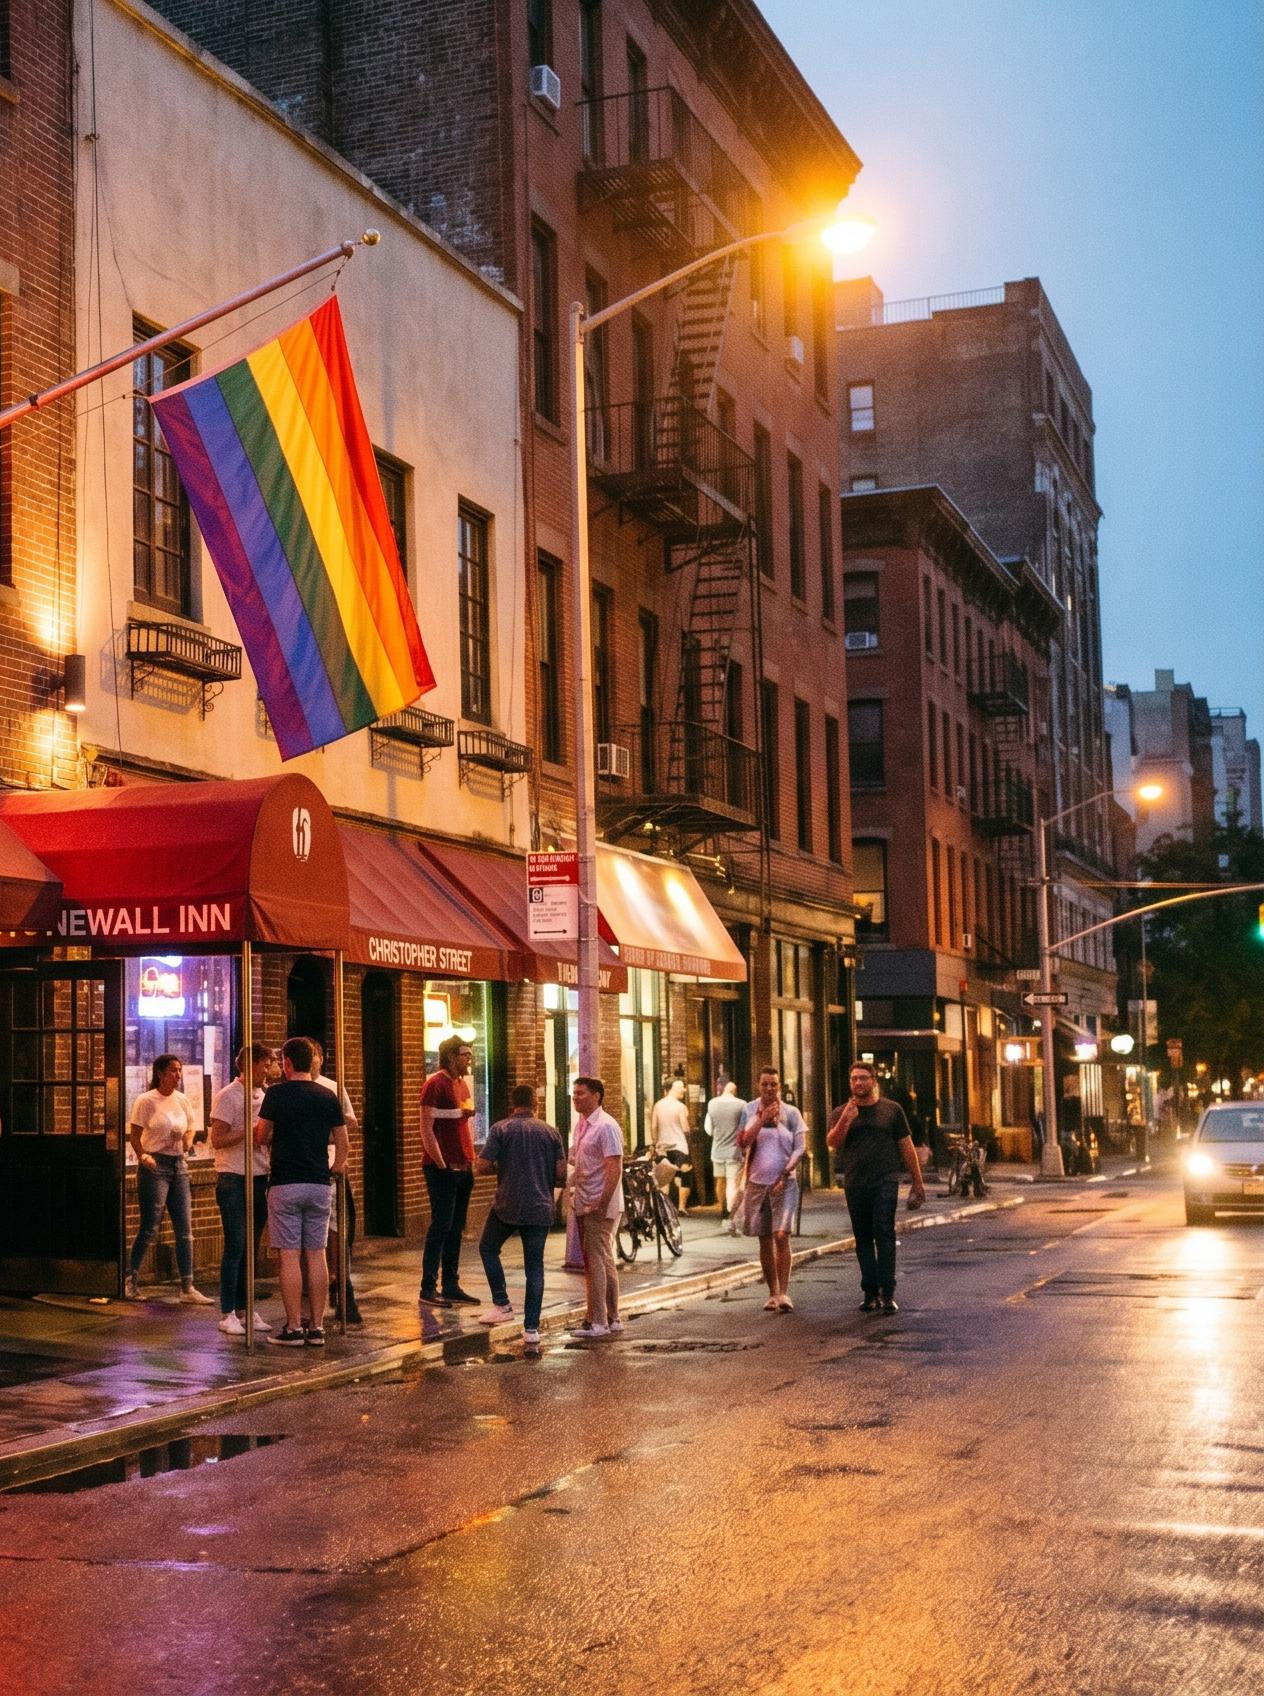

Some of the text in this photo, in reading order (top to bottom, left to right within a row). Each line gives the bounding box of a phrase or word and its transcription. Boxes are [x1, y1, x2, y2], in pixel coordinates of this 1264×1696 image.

[179, 903, 231, 933] INN
[368, 936, 473, 972] CHRISTOPHER STREET
